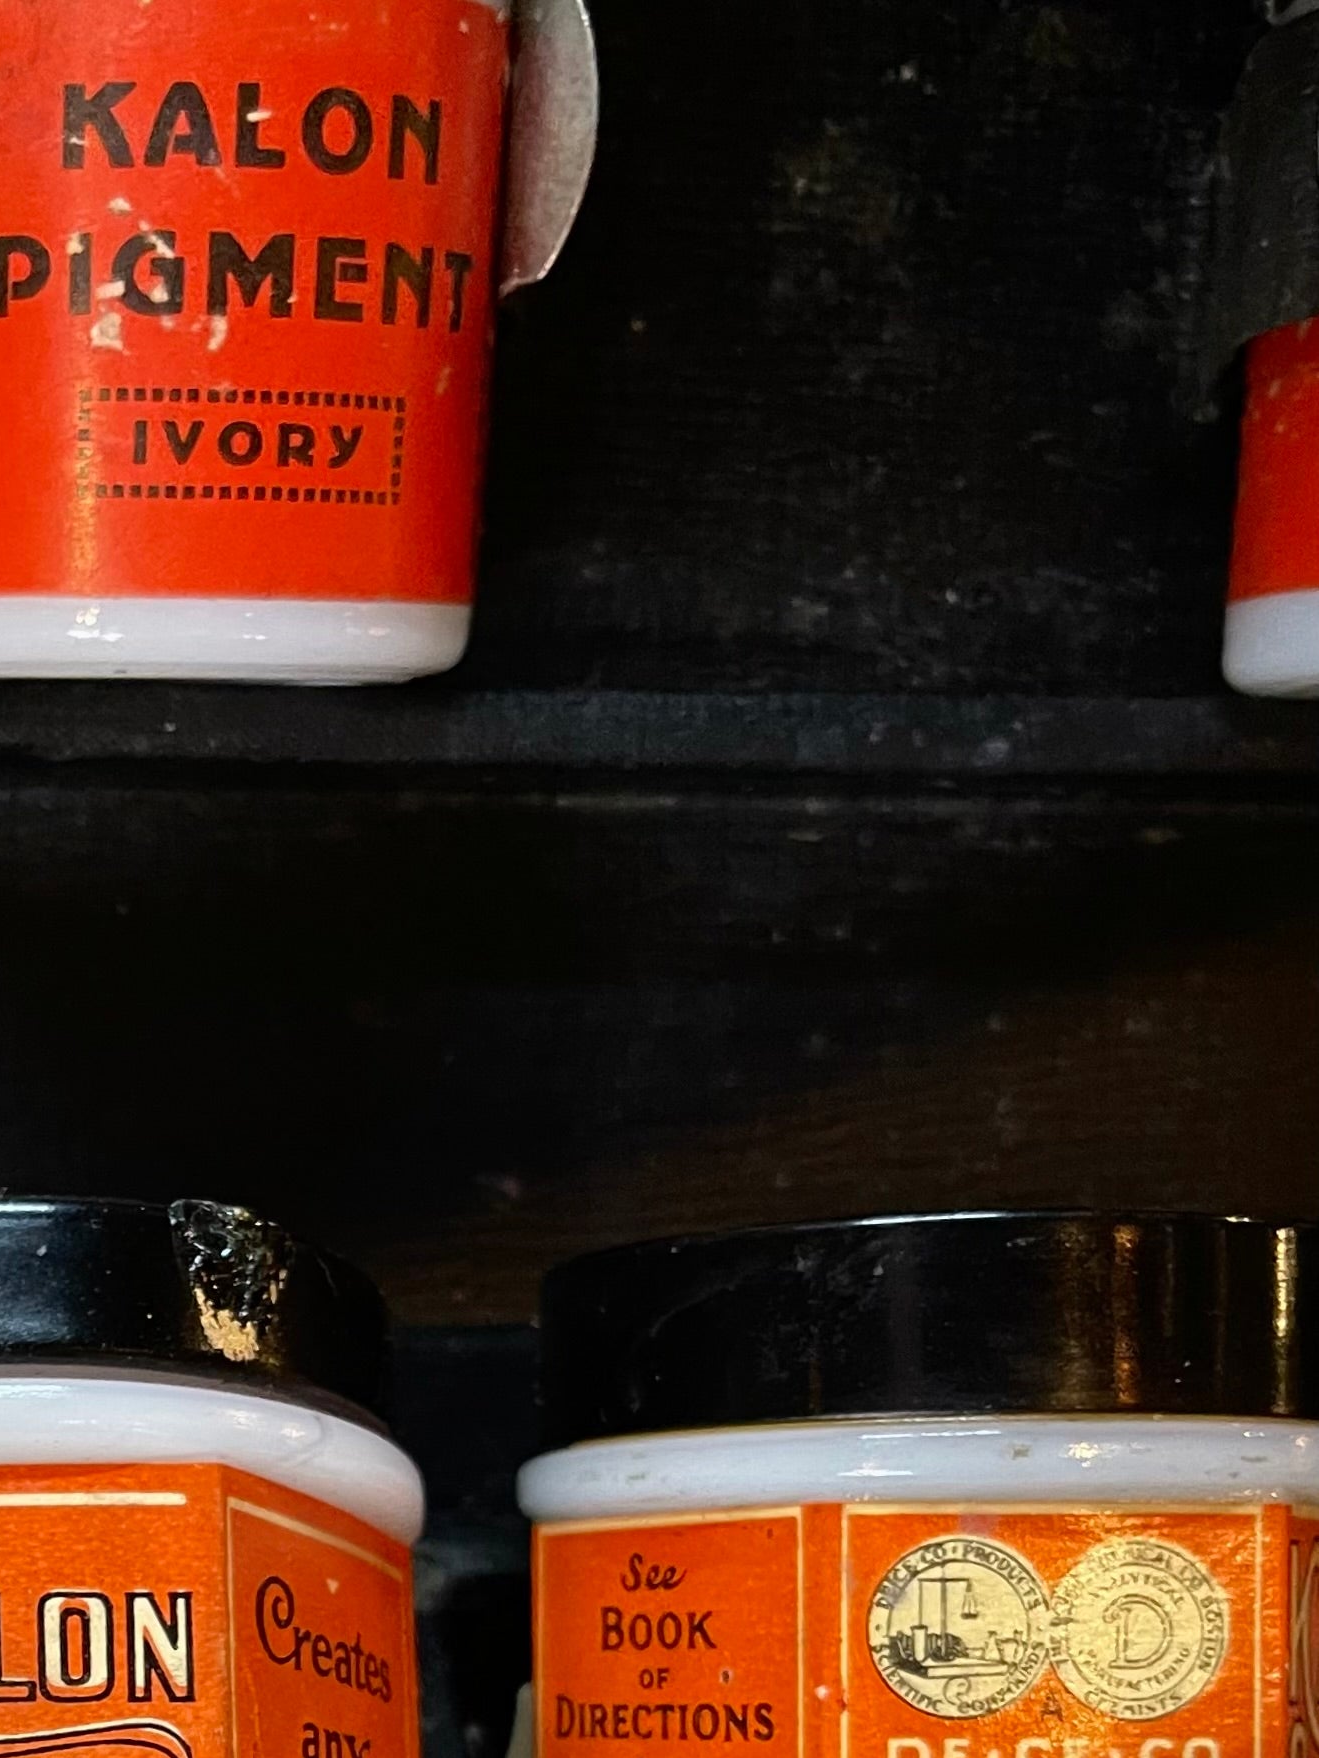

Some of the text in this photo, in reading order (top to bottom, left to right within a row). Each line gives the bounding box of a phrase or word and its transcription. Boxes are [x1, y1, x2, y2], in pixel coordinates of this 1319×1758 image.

[61, 81, 444, 185] KALON
[132, 420, 363, 469] IVORY
[620, 1553, 688, 1592] See
[255, 1575, 393, 1702] Creates
[601, 1606, 717, 1651] BOOK
[639, 1667, 670, 1689] OF
[555, 1694, 775, 1742] DIRECTIONS
